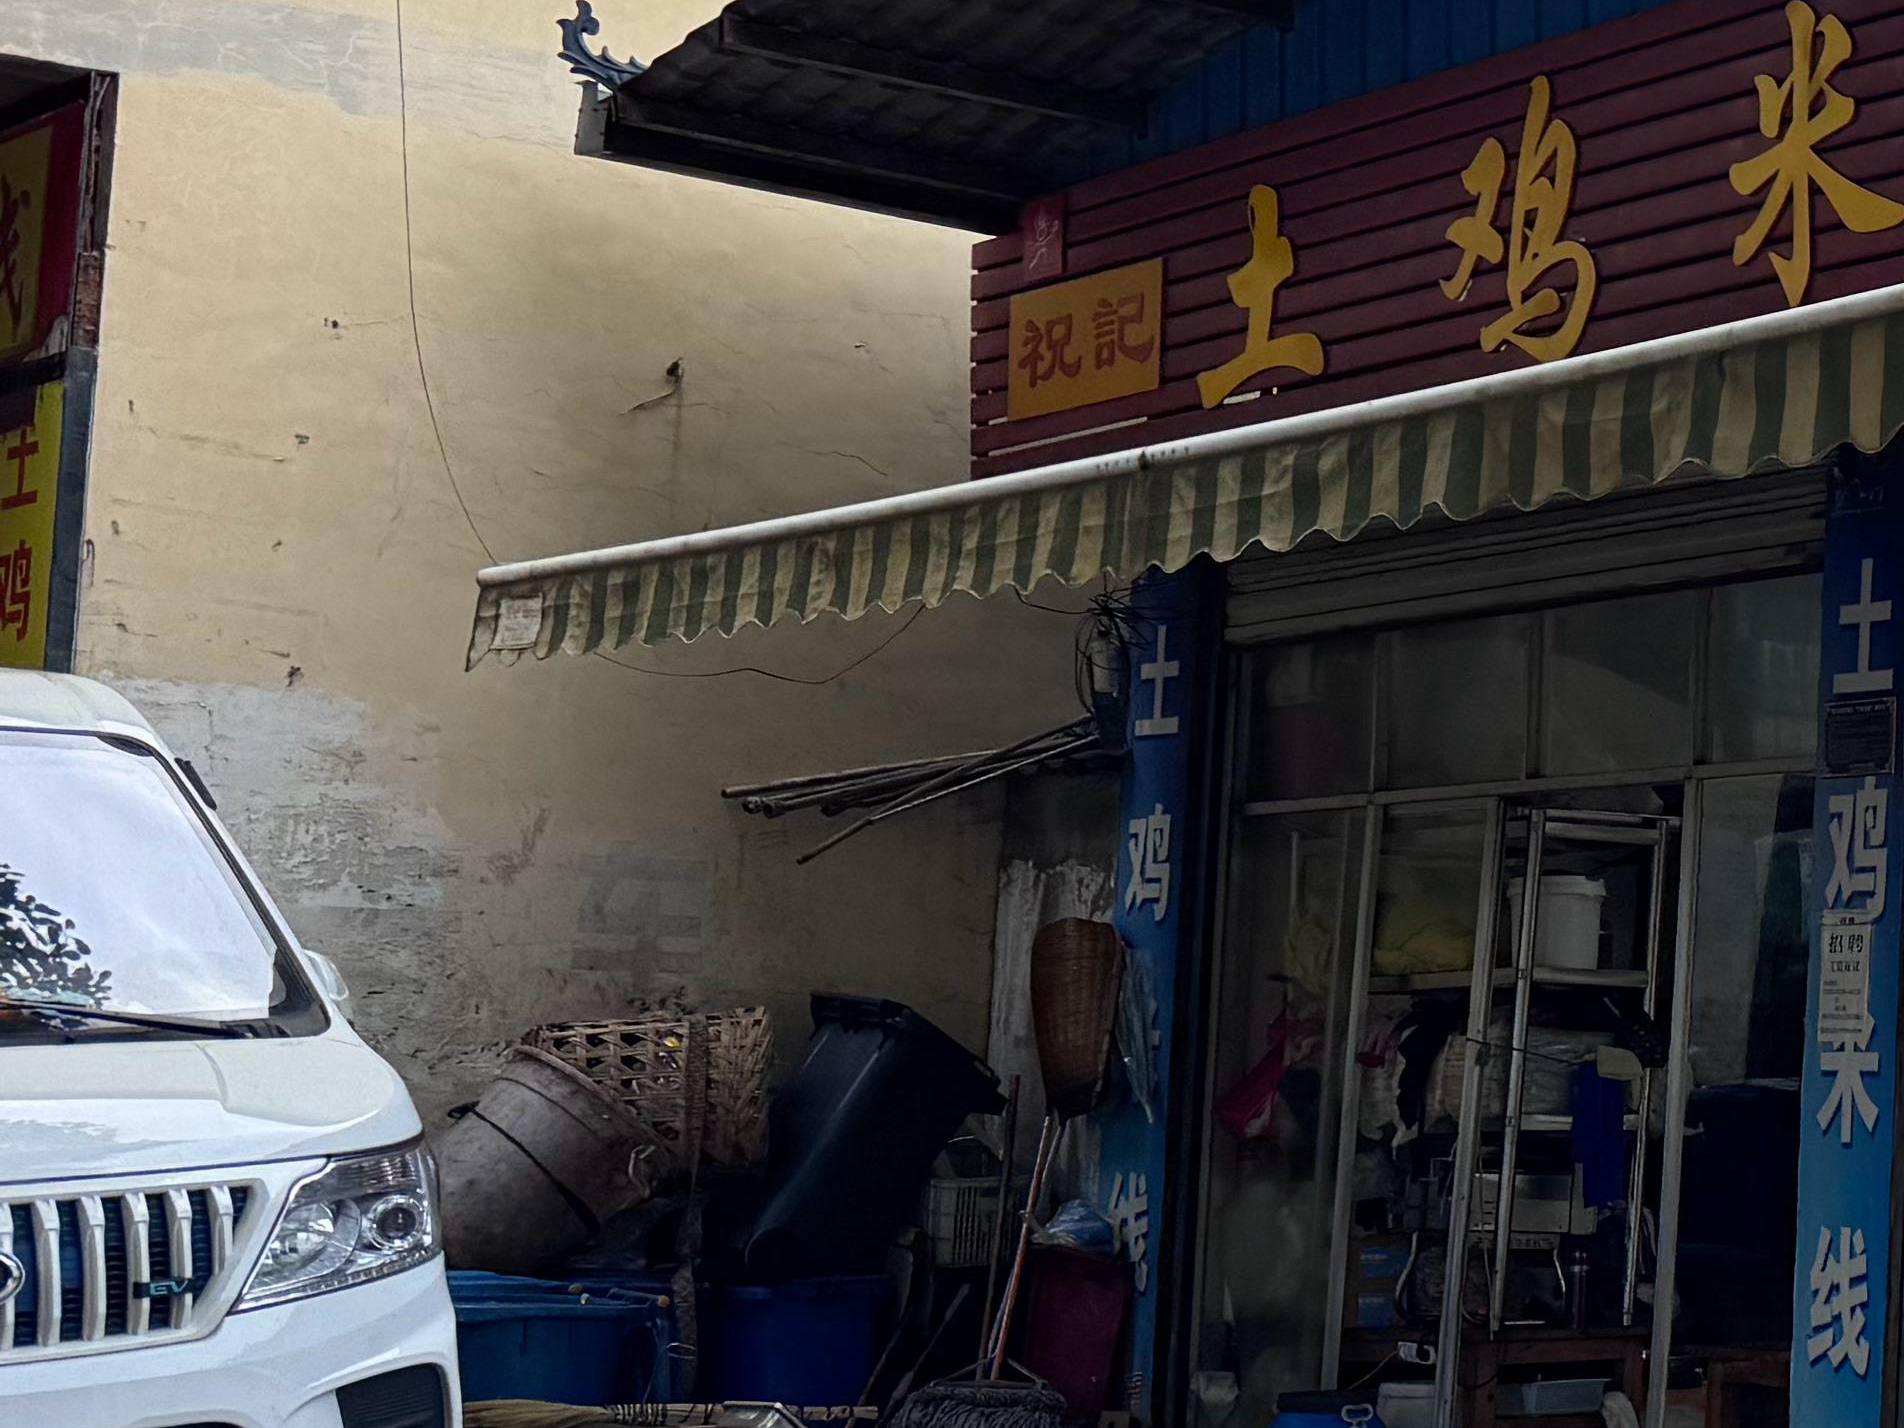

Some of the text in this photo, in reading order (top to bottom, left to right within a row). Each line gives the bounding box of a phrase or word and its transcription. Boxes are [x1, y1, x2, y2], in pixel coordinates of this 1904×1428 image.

[1018, 292, 1154, 388] 祝記
[1105, 625, 1180, 1293] 土鸡线
[149, 1278, 189, 1297] EV
